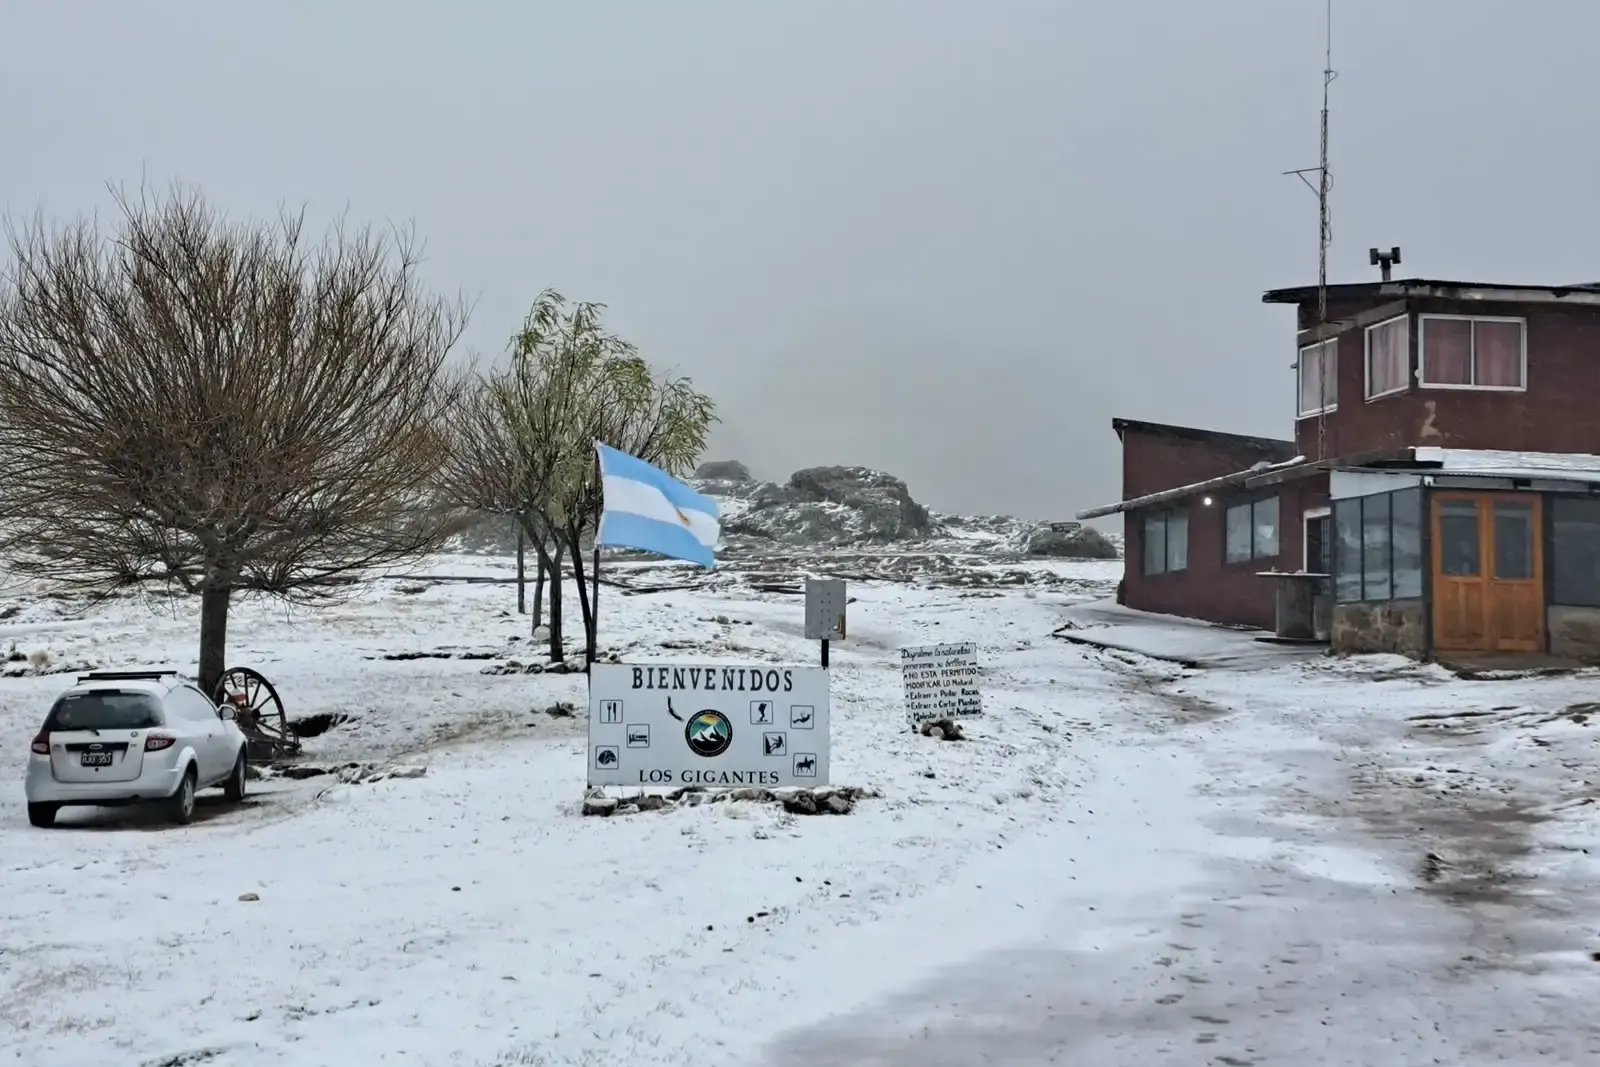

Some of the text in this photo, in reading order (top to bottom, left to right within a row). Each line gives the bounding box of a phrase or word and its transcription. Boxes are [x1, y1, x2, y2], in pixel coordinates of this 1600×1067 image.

[631, 667, 793, 692] BIENVENIDOS
[921, 670, 938, 679] ESTA
[941, 667, 976, 677] PERMITIDO
[905, 680, 941, 689] MODIFICAR
[943, 679, 951, 687] LO
[639, 769, 779, 785] LOS GIGANTES
